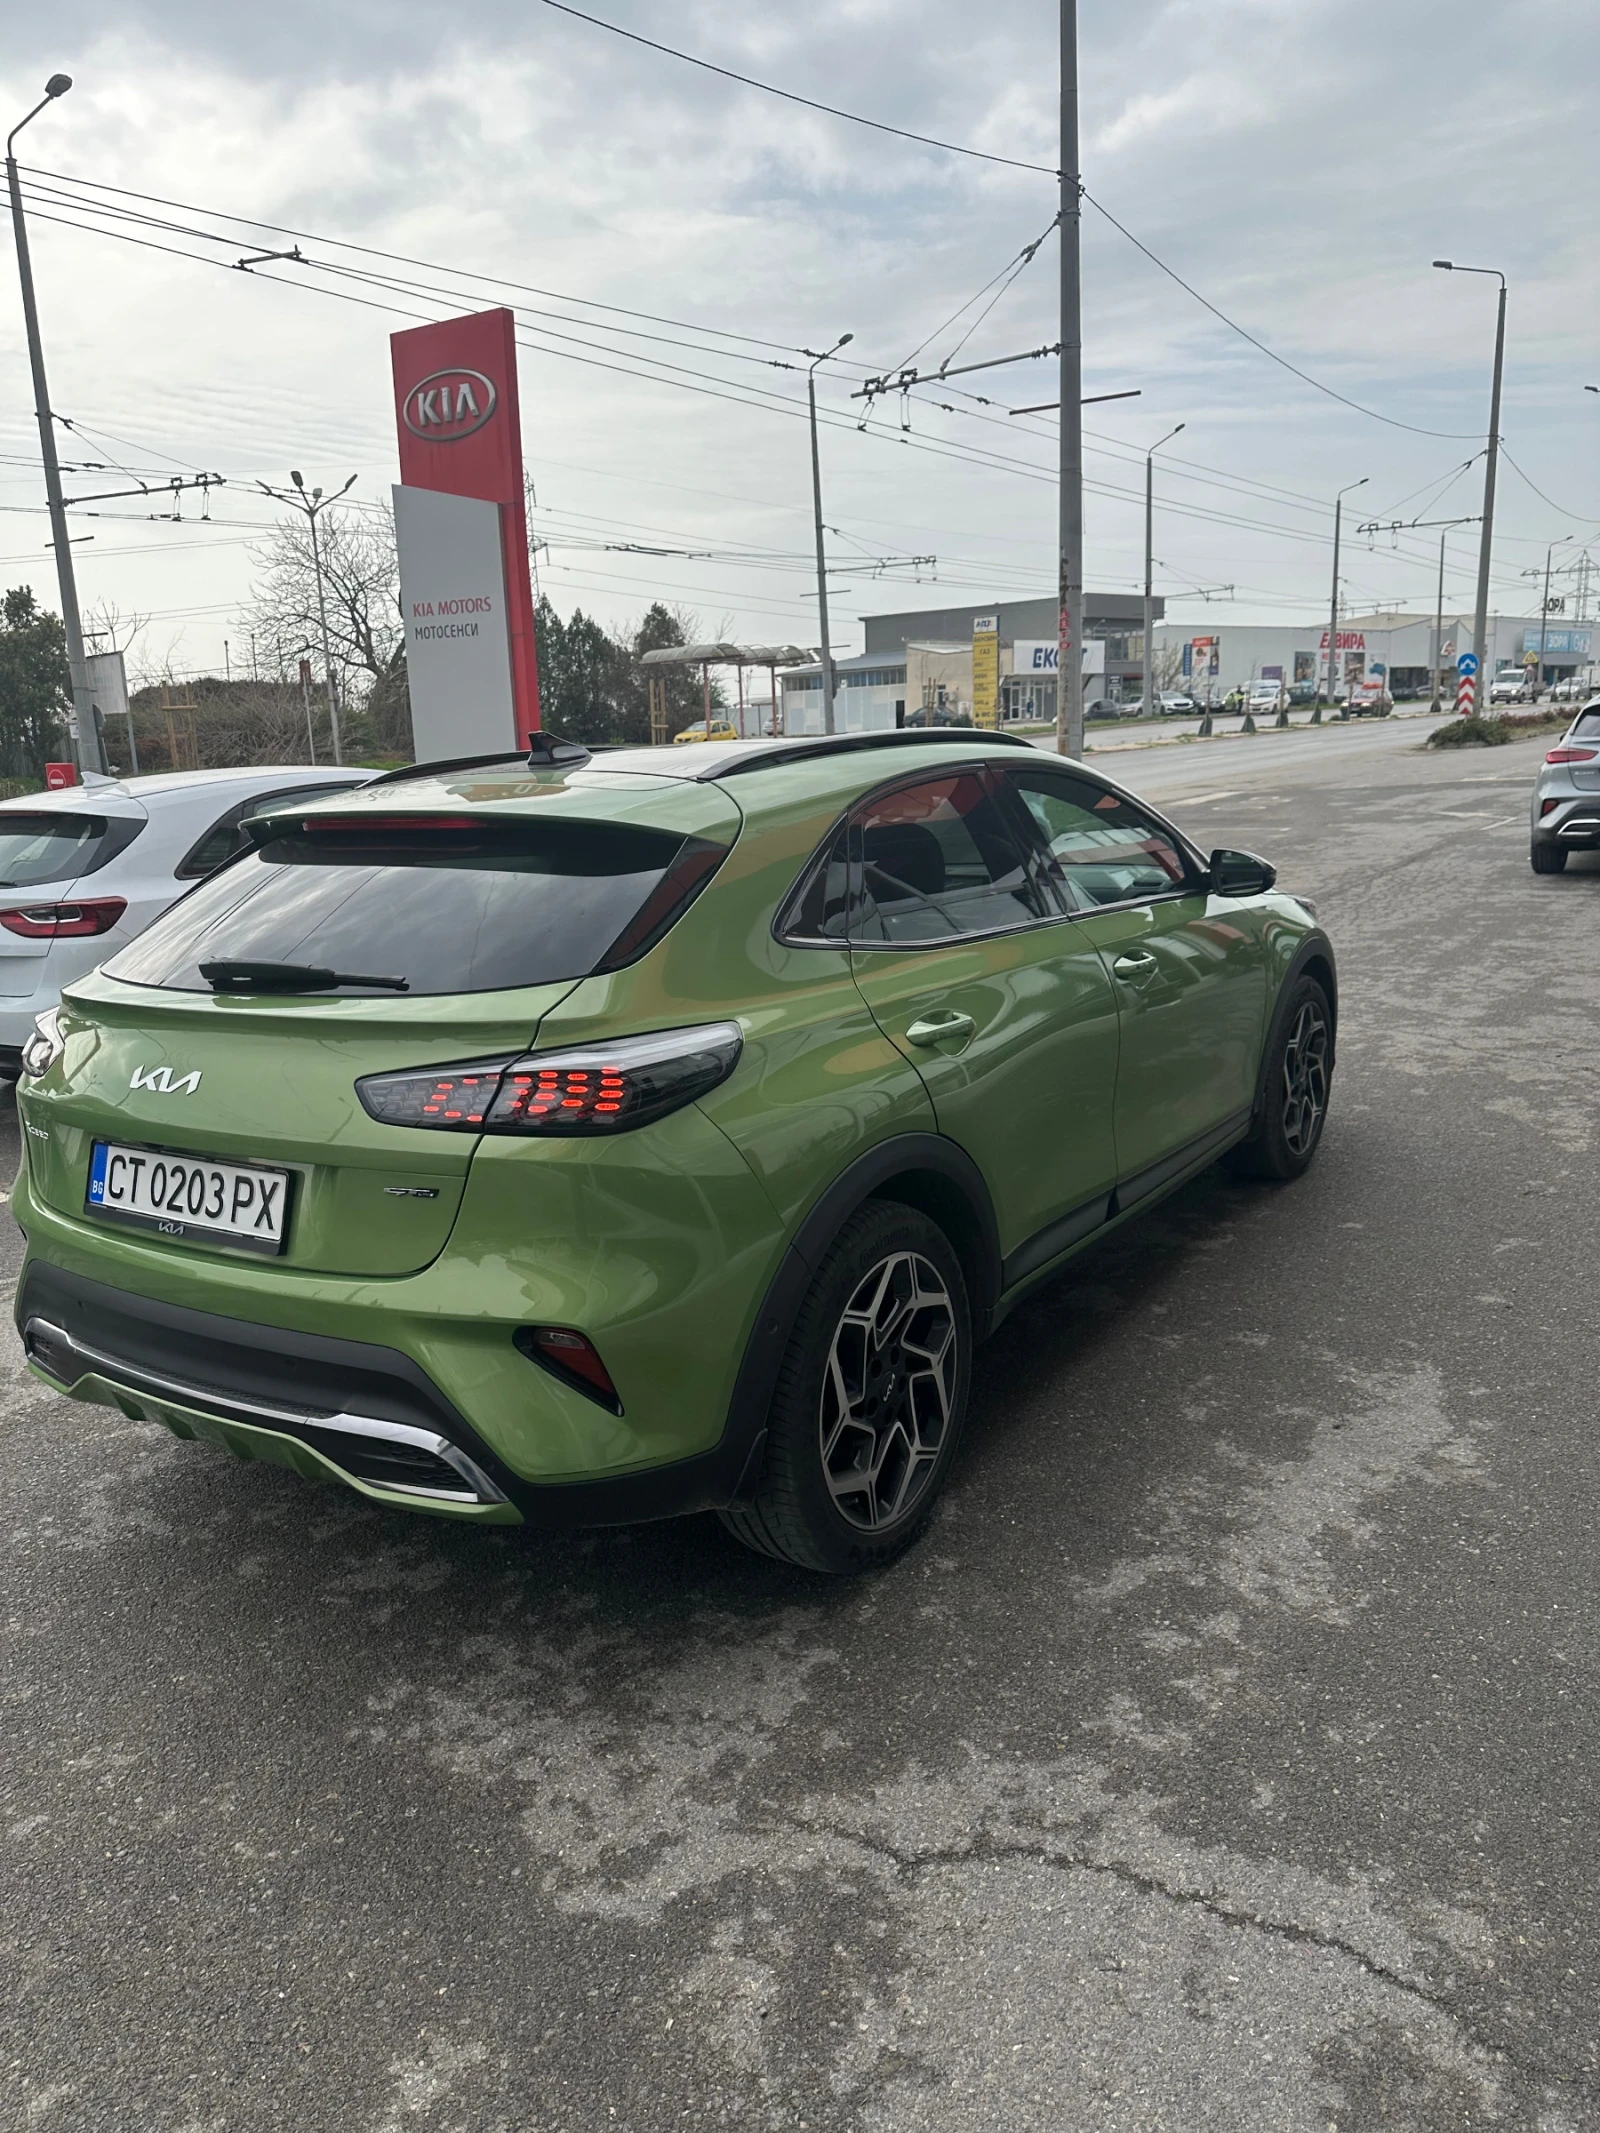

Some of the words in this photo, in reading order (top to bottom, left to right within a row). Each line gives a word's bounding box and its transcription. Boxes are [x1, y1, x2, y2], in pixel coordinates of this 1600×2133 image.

[417, 383, 480, 427] KIA
[413, 602, 435, 617] KIA
[437, 596, 491, 616] MOTORS
[415, 623, 479, 641] МОТОСЕНСИ
[1319, 632, 1366, 649] ЕВИРА
[129, 1064, 203, 1096] KIA
[92, 1178, 104, 1195] BG
[157, 1220, 185, 1237] KIA
